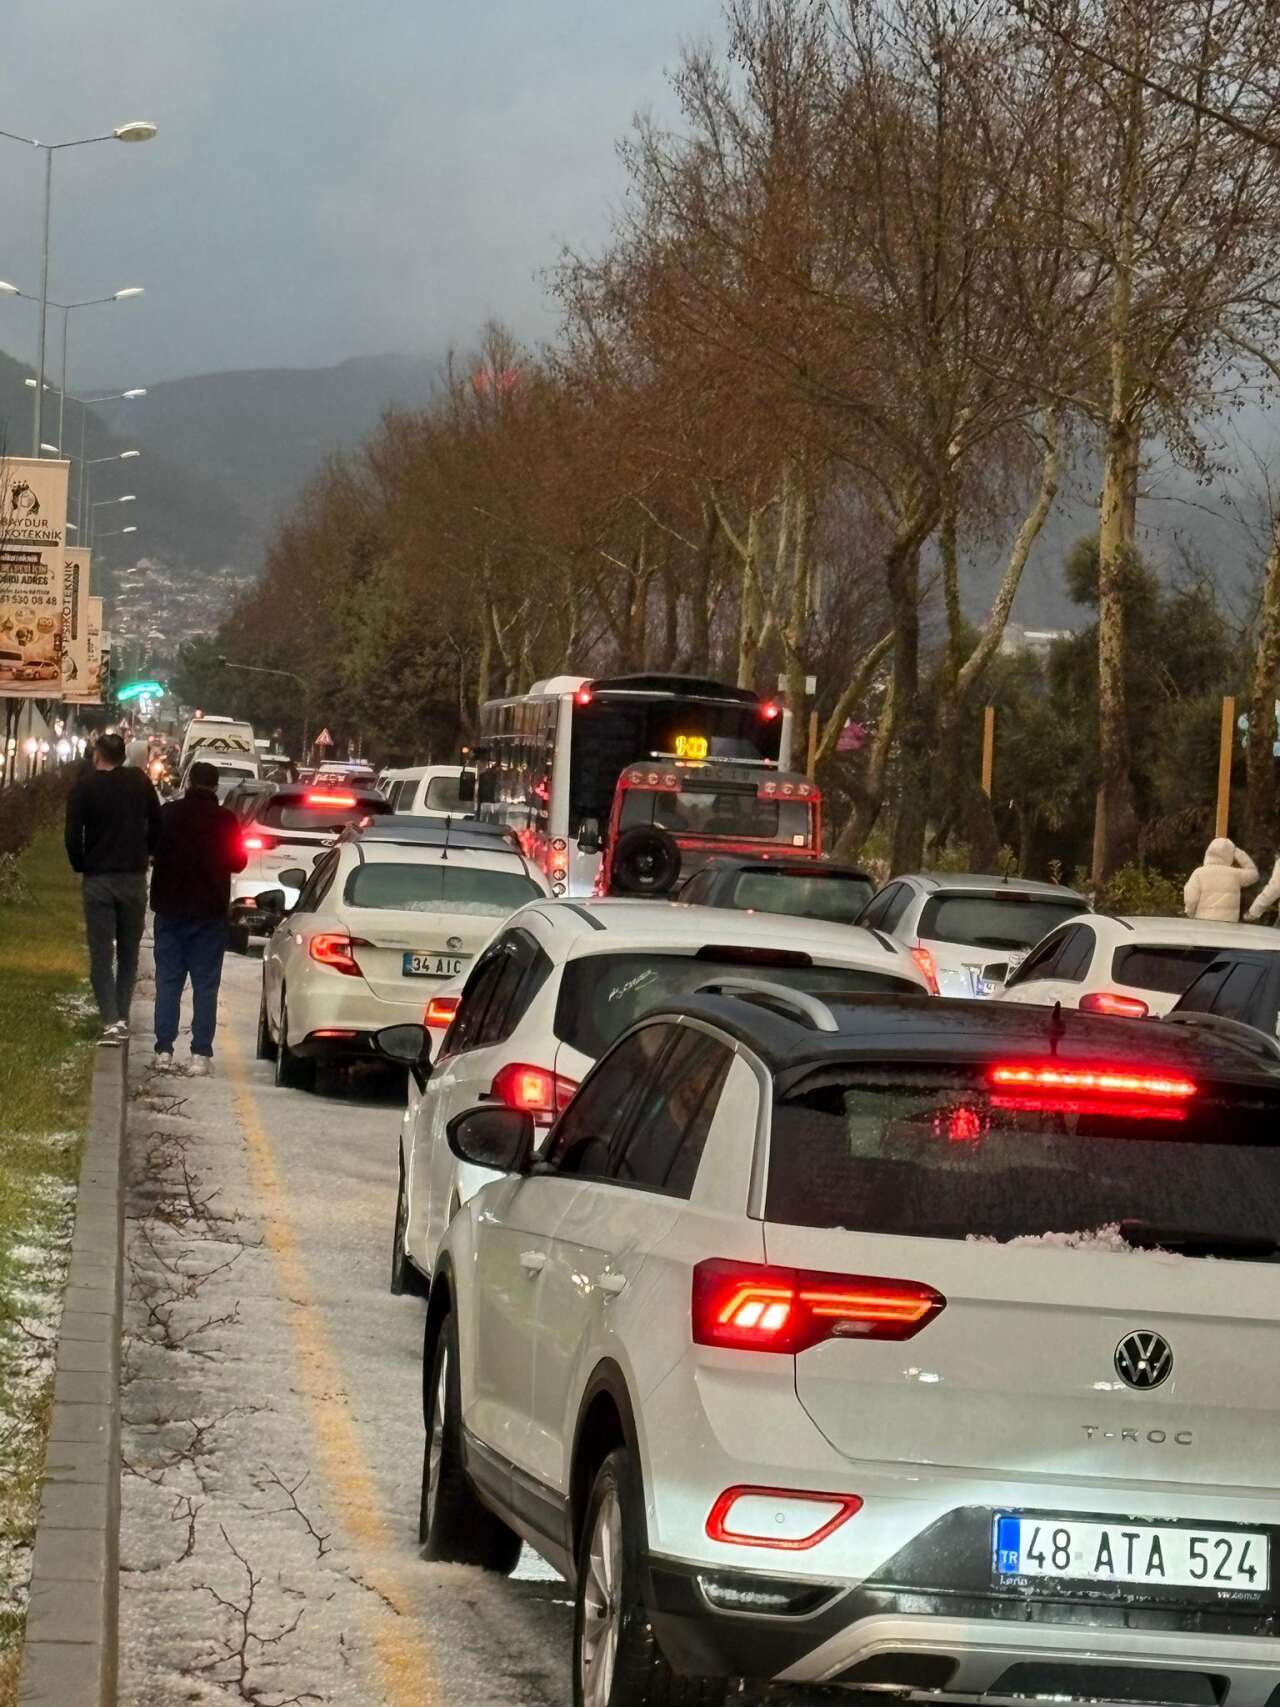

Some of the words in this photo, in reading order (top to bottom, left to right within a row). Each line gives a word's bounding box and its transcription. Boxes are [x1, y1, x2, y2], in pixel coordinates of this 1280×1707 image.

[413, 957, 430, 972] 34
[435, 959, 462, 974] AIC
[1081, 1425, 1193, 1446] T-ROC
[1026, 1526, 1072, 1571] 48
[1094, 1531, 1166, 1578] ATA
[1189, 1536, 1258, 1583] 524
